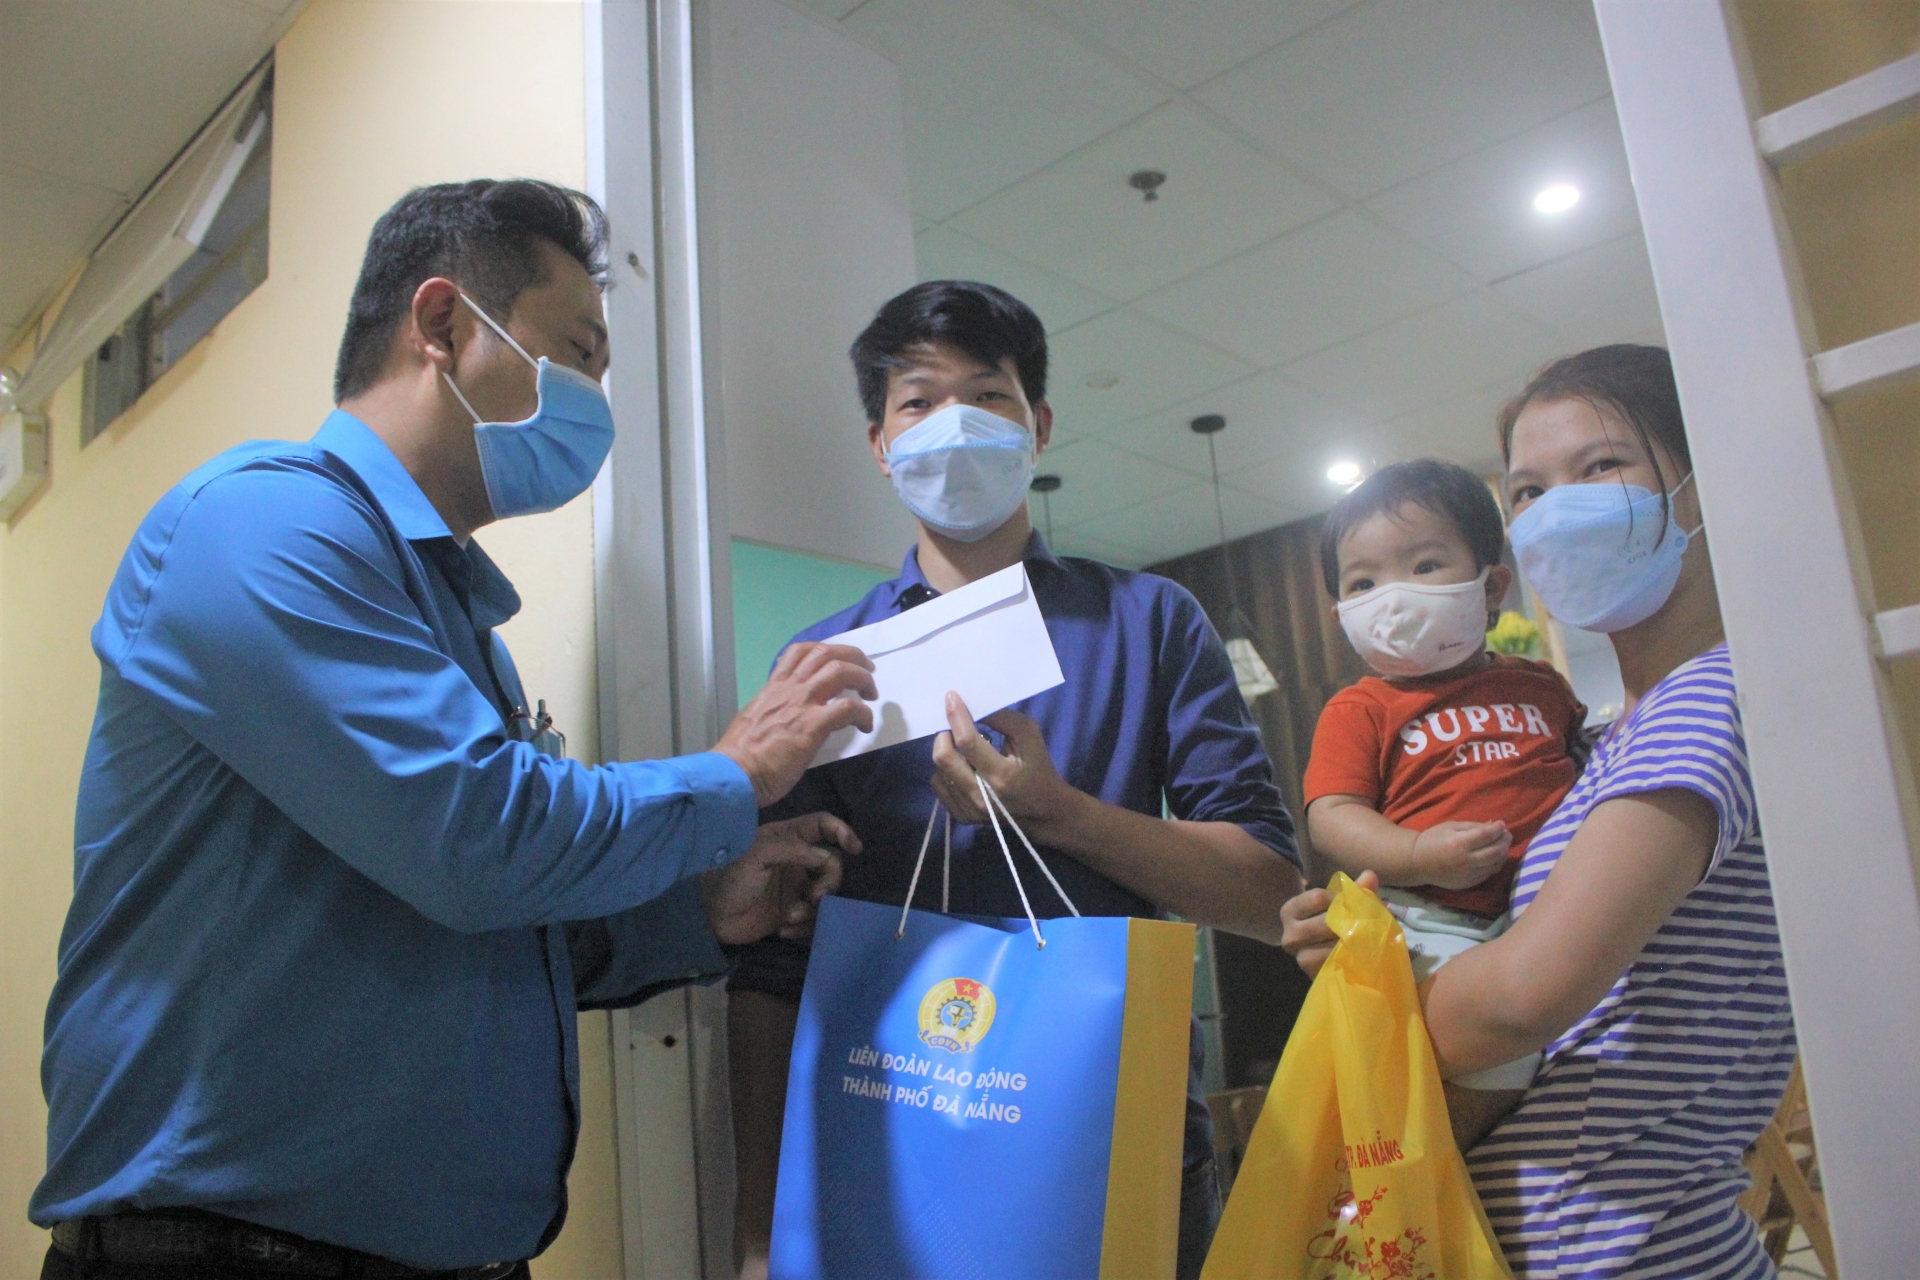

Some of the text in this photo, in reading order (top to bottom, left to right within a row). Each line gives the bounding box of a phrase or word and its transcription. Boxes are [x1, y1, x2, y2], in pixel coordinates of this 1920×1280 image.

[1401, 703, 1552, 755] SUPER
[1454, 741, 1520, 766] STAR
[848, 1046, 1027, 1092] LIÊN ĐOÀN LAO ĐỘNG
[843, 1075, 892, 1102] THÀNH
[894, 1085, 933, 1108] PHỐ
[933, 1094, 961, 1116] ĐÀ
